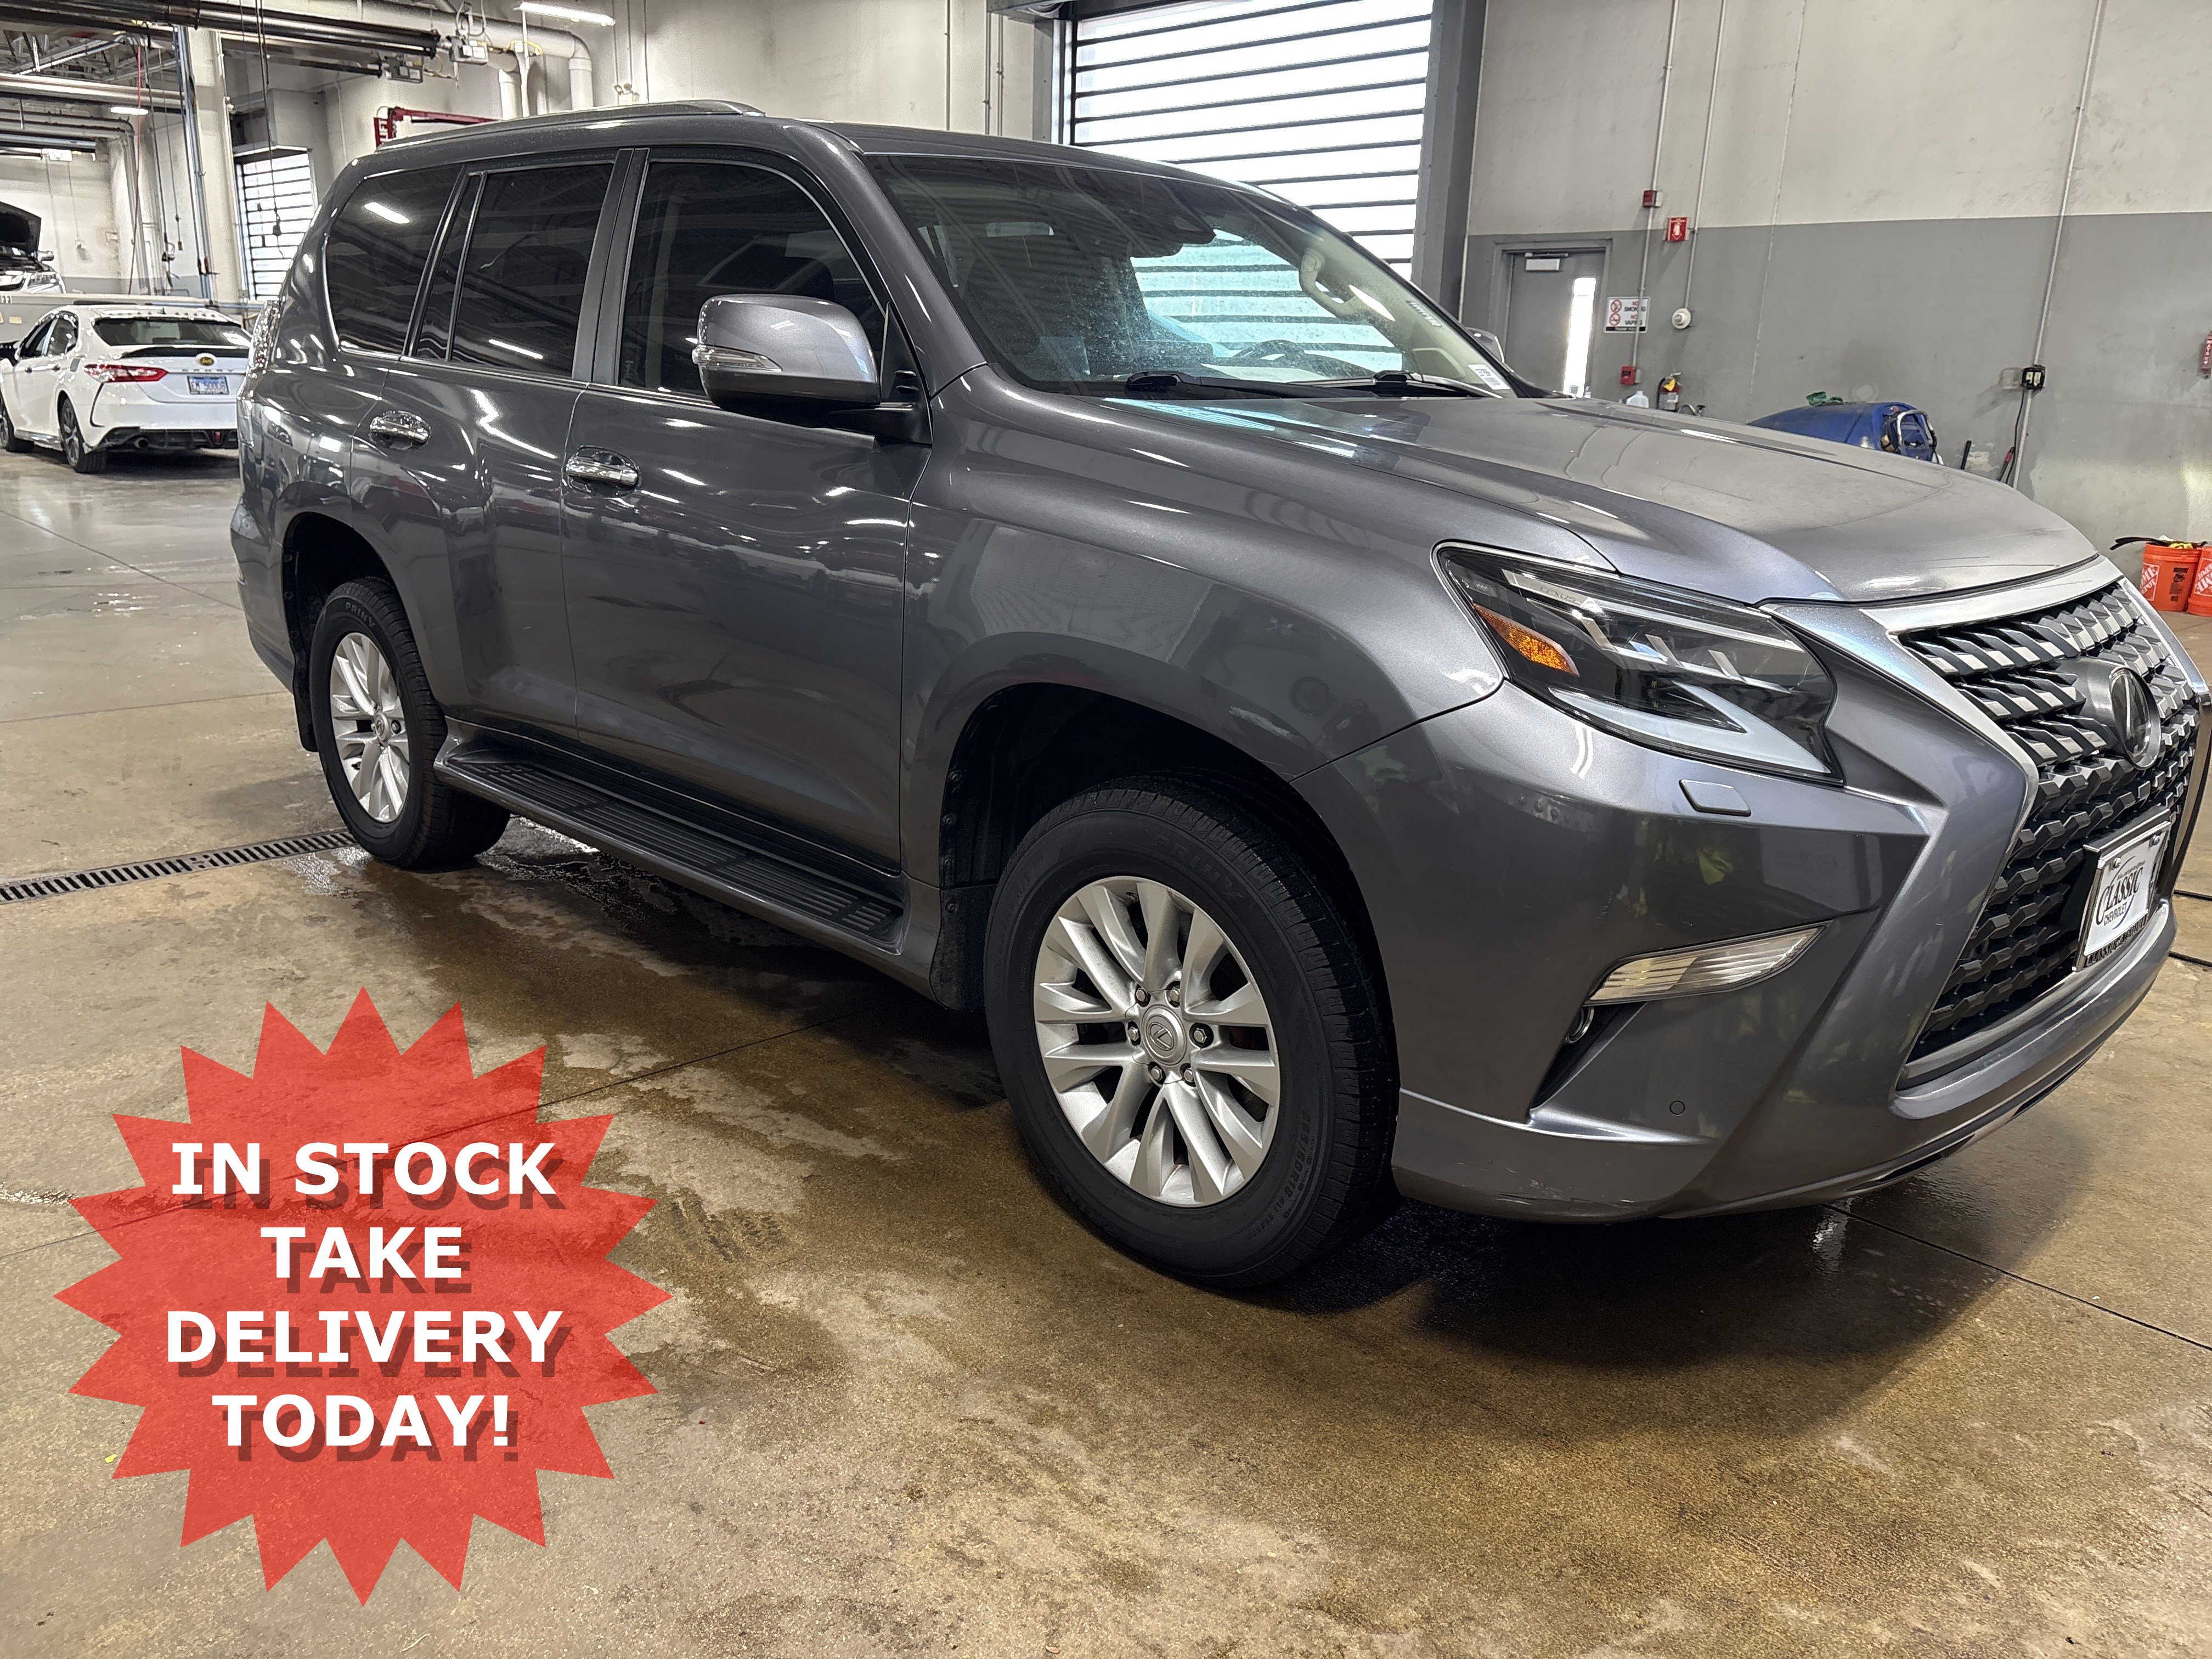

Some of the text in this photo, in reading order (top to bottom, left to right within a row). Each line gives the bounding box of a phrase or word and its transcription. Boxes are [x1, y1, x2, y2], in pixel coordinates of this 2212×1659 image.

[1539, 586, 1576, 602] LEXUS
[1152, 833, 1244, 899] PRINX
[2096, 866, 2144, 926] CLASSIC
[2103, 901, 2128, 927] CHEVROLET
